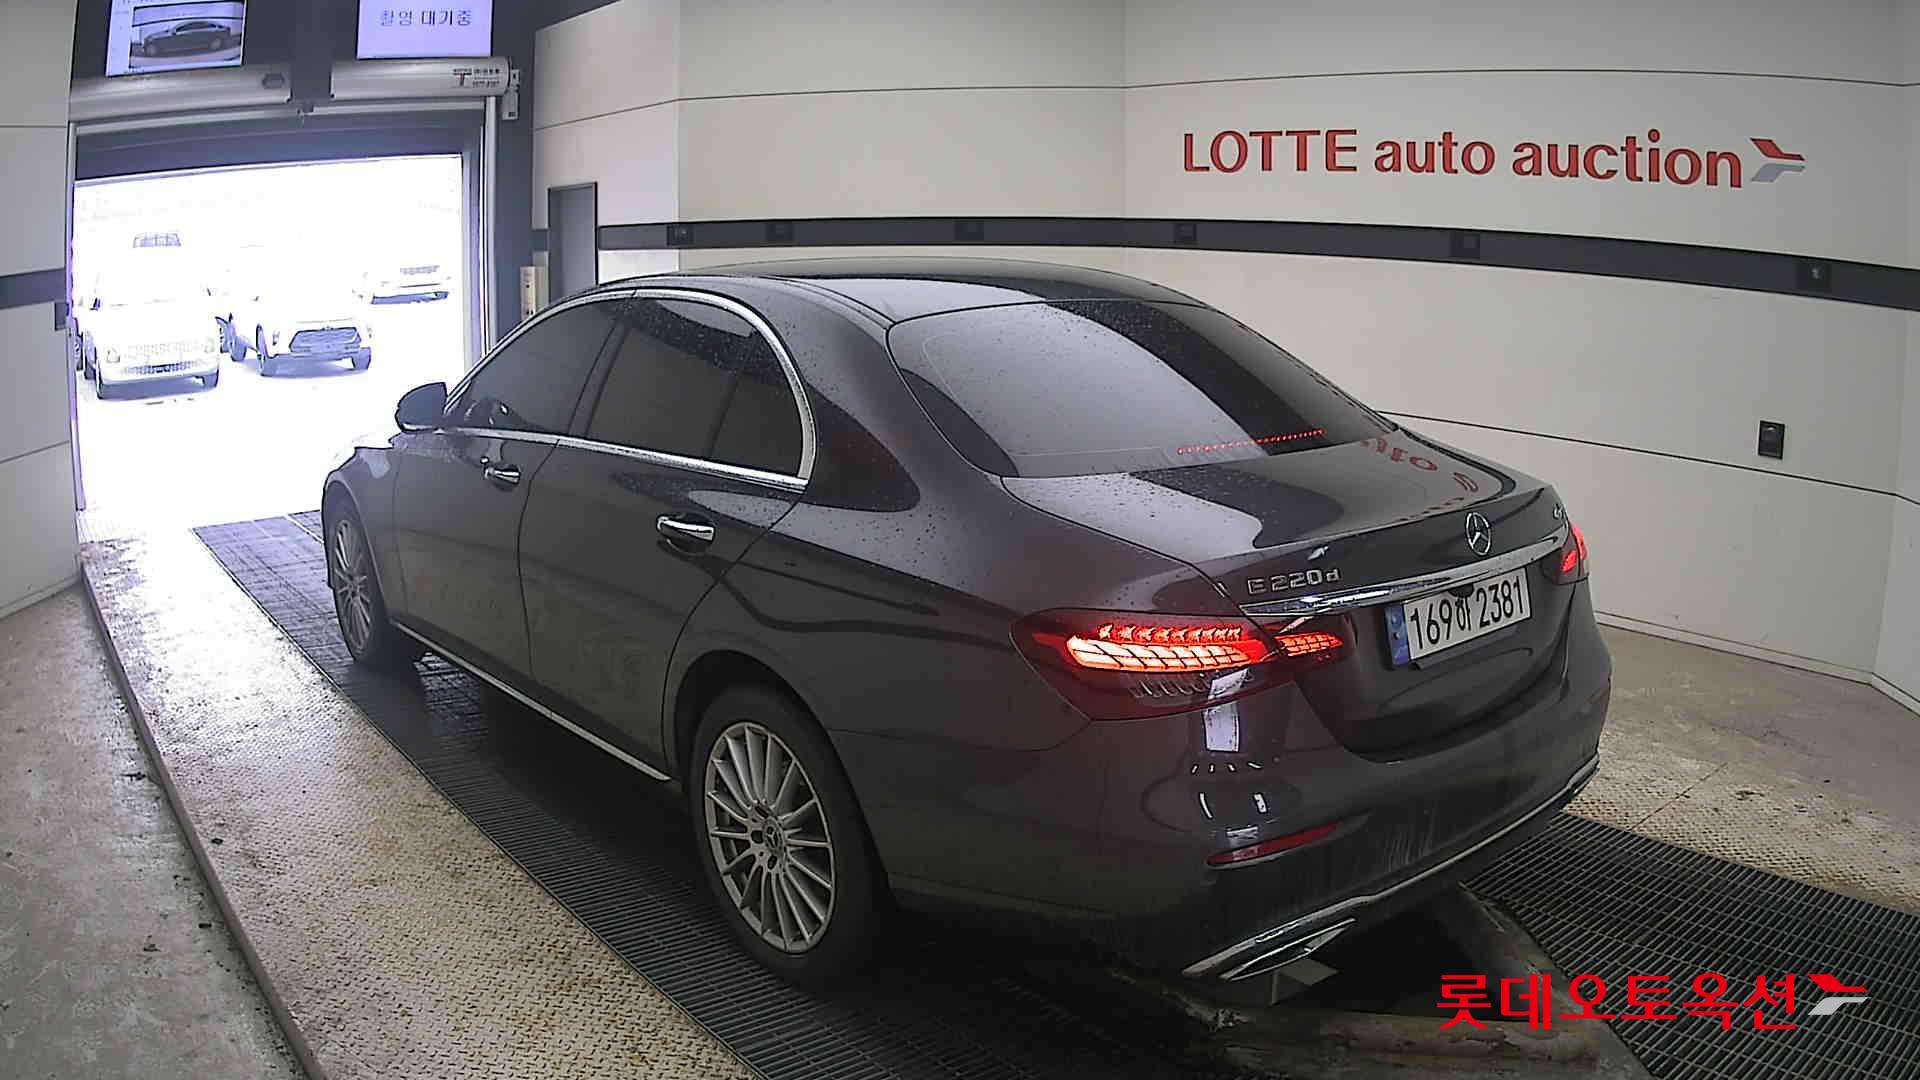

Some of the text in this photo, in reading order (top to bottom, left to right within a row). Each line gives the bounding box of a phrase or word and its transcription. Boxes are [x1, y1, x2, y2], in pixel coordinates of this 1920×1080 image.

[420, 8, 472, 26] 대기중
[1184, 128, 1743, 188] LOTTE auto auction
[1475, 575, 1524, 628] 2381
